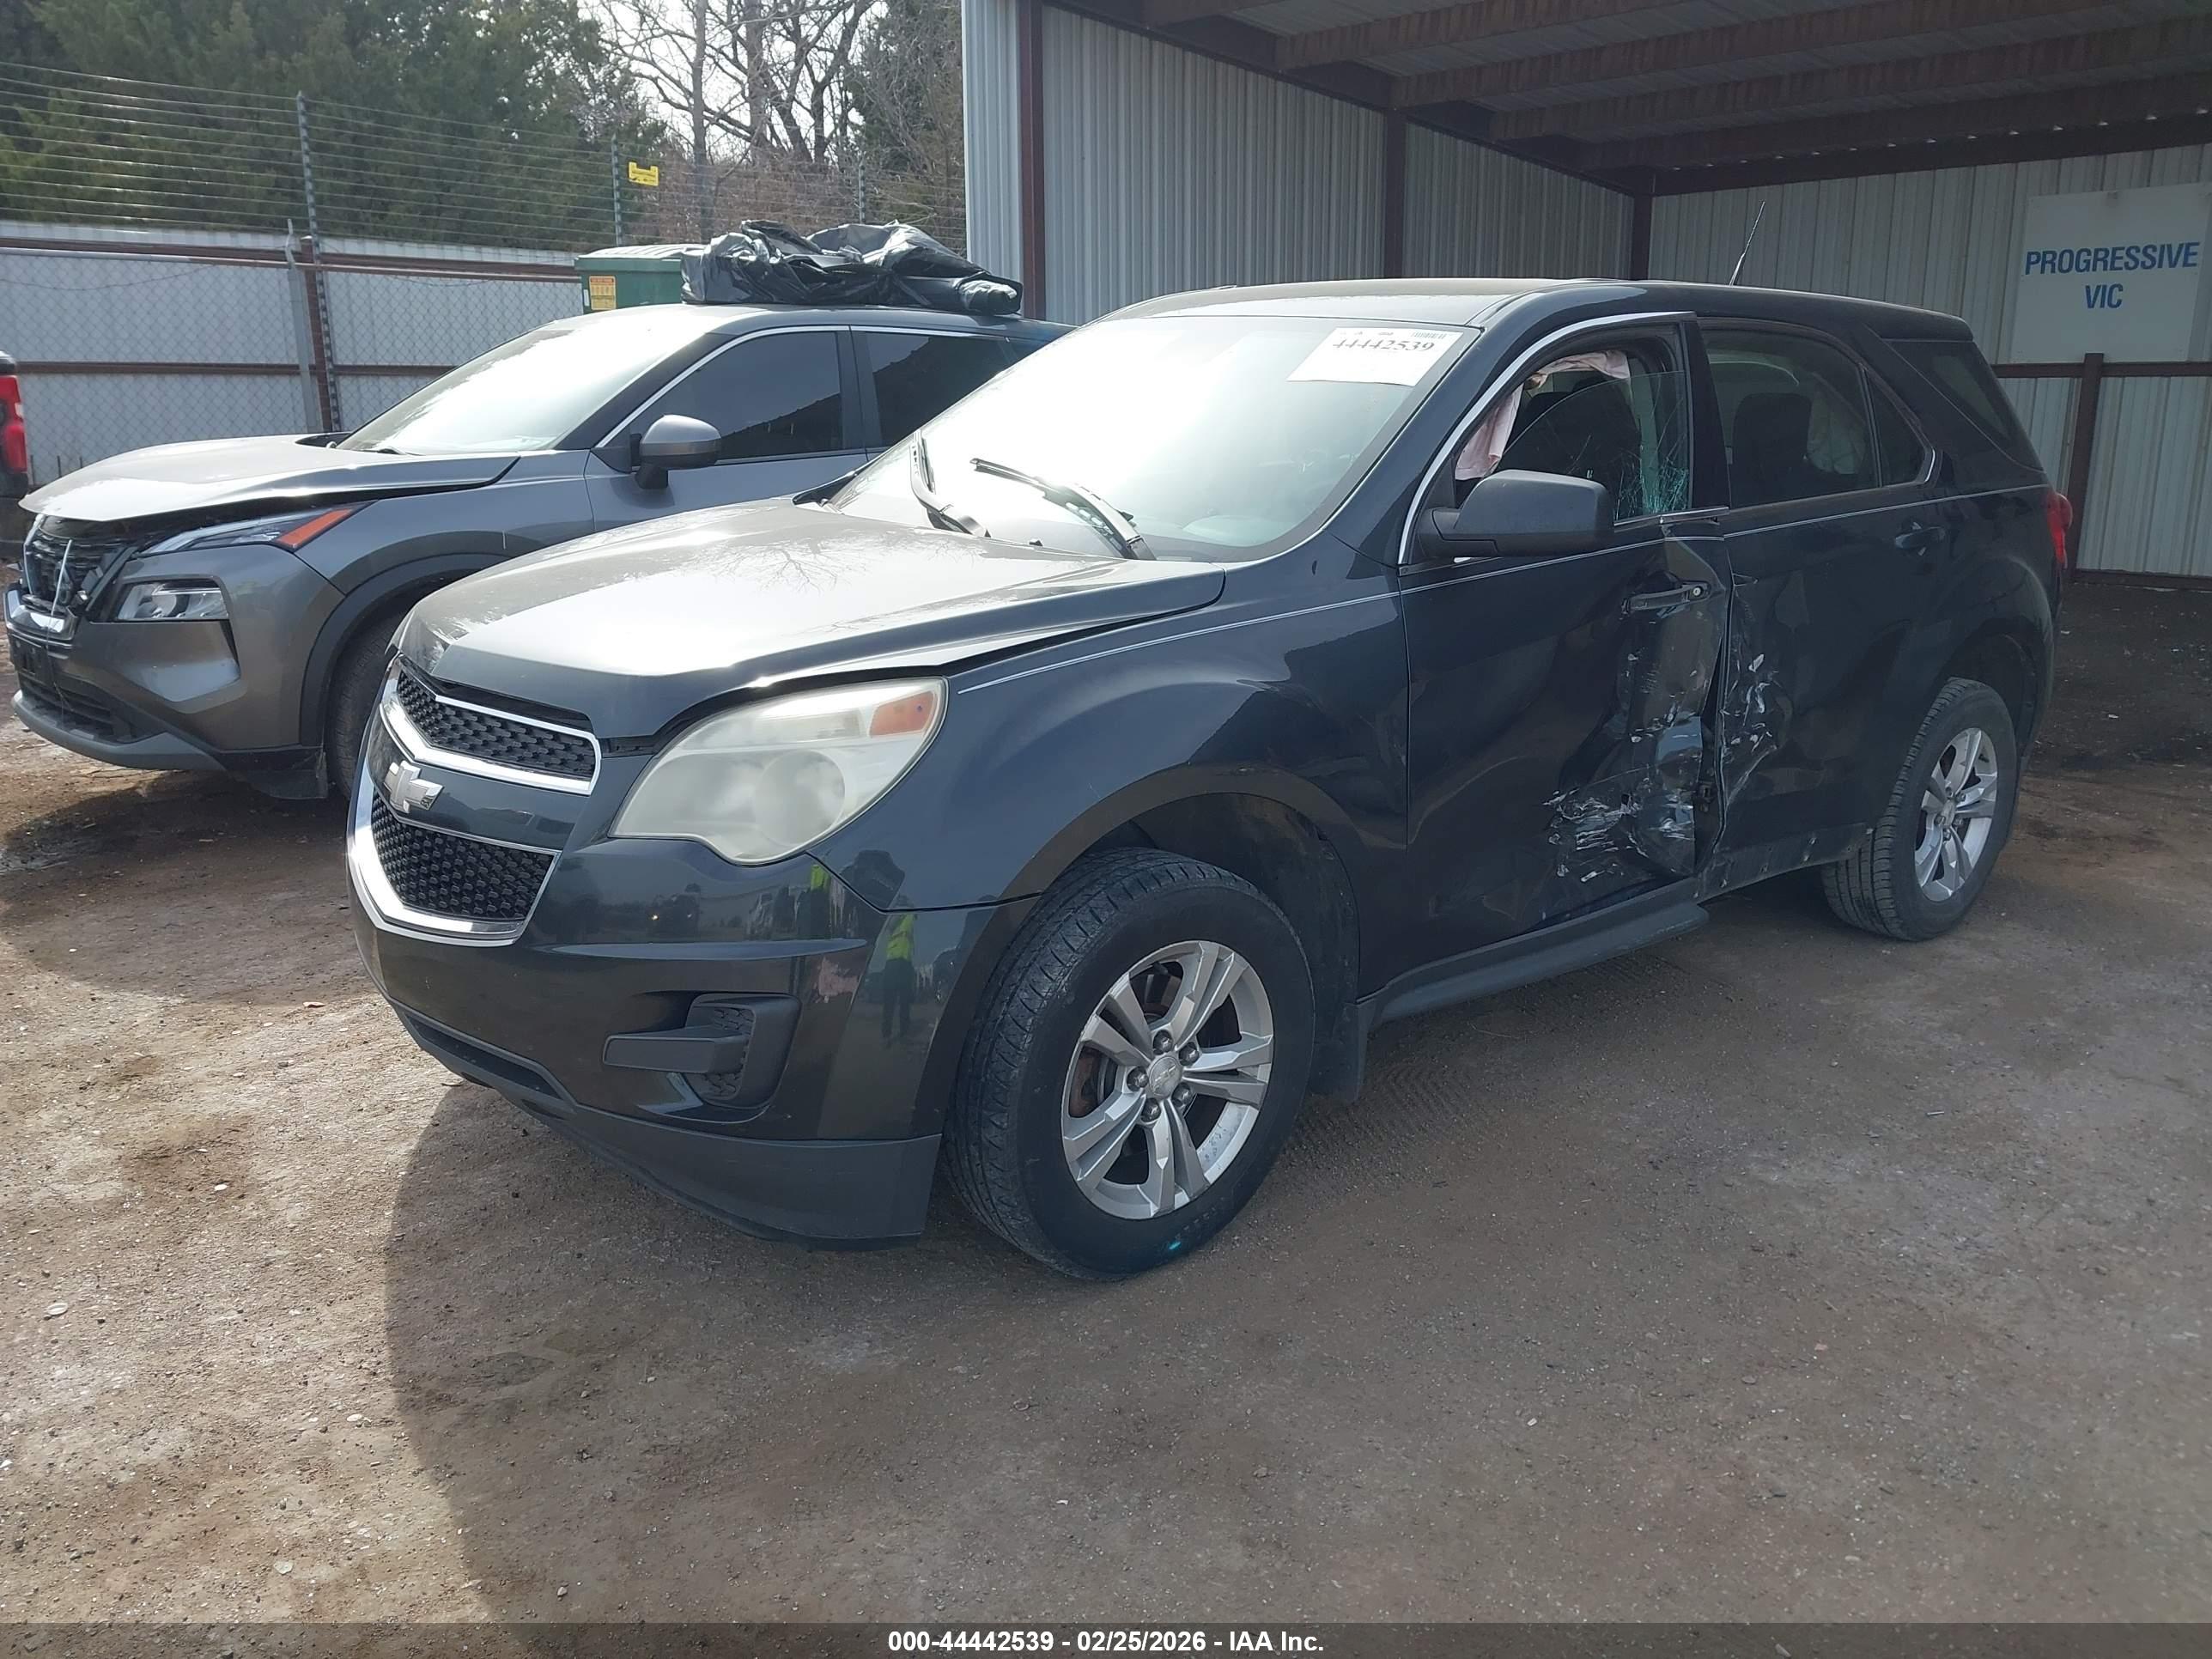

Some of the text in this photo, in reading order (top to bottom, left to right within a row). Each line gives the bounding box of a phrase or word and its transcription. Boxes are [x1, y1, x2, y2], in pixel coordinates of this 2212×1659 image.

[2025, 241, 2200, 276] PROGRESSIVE
[2085, 283, 2124, 309] VIC
[1332, 338, 1436, 352] 44442539
